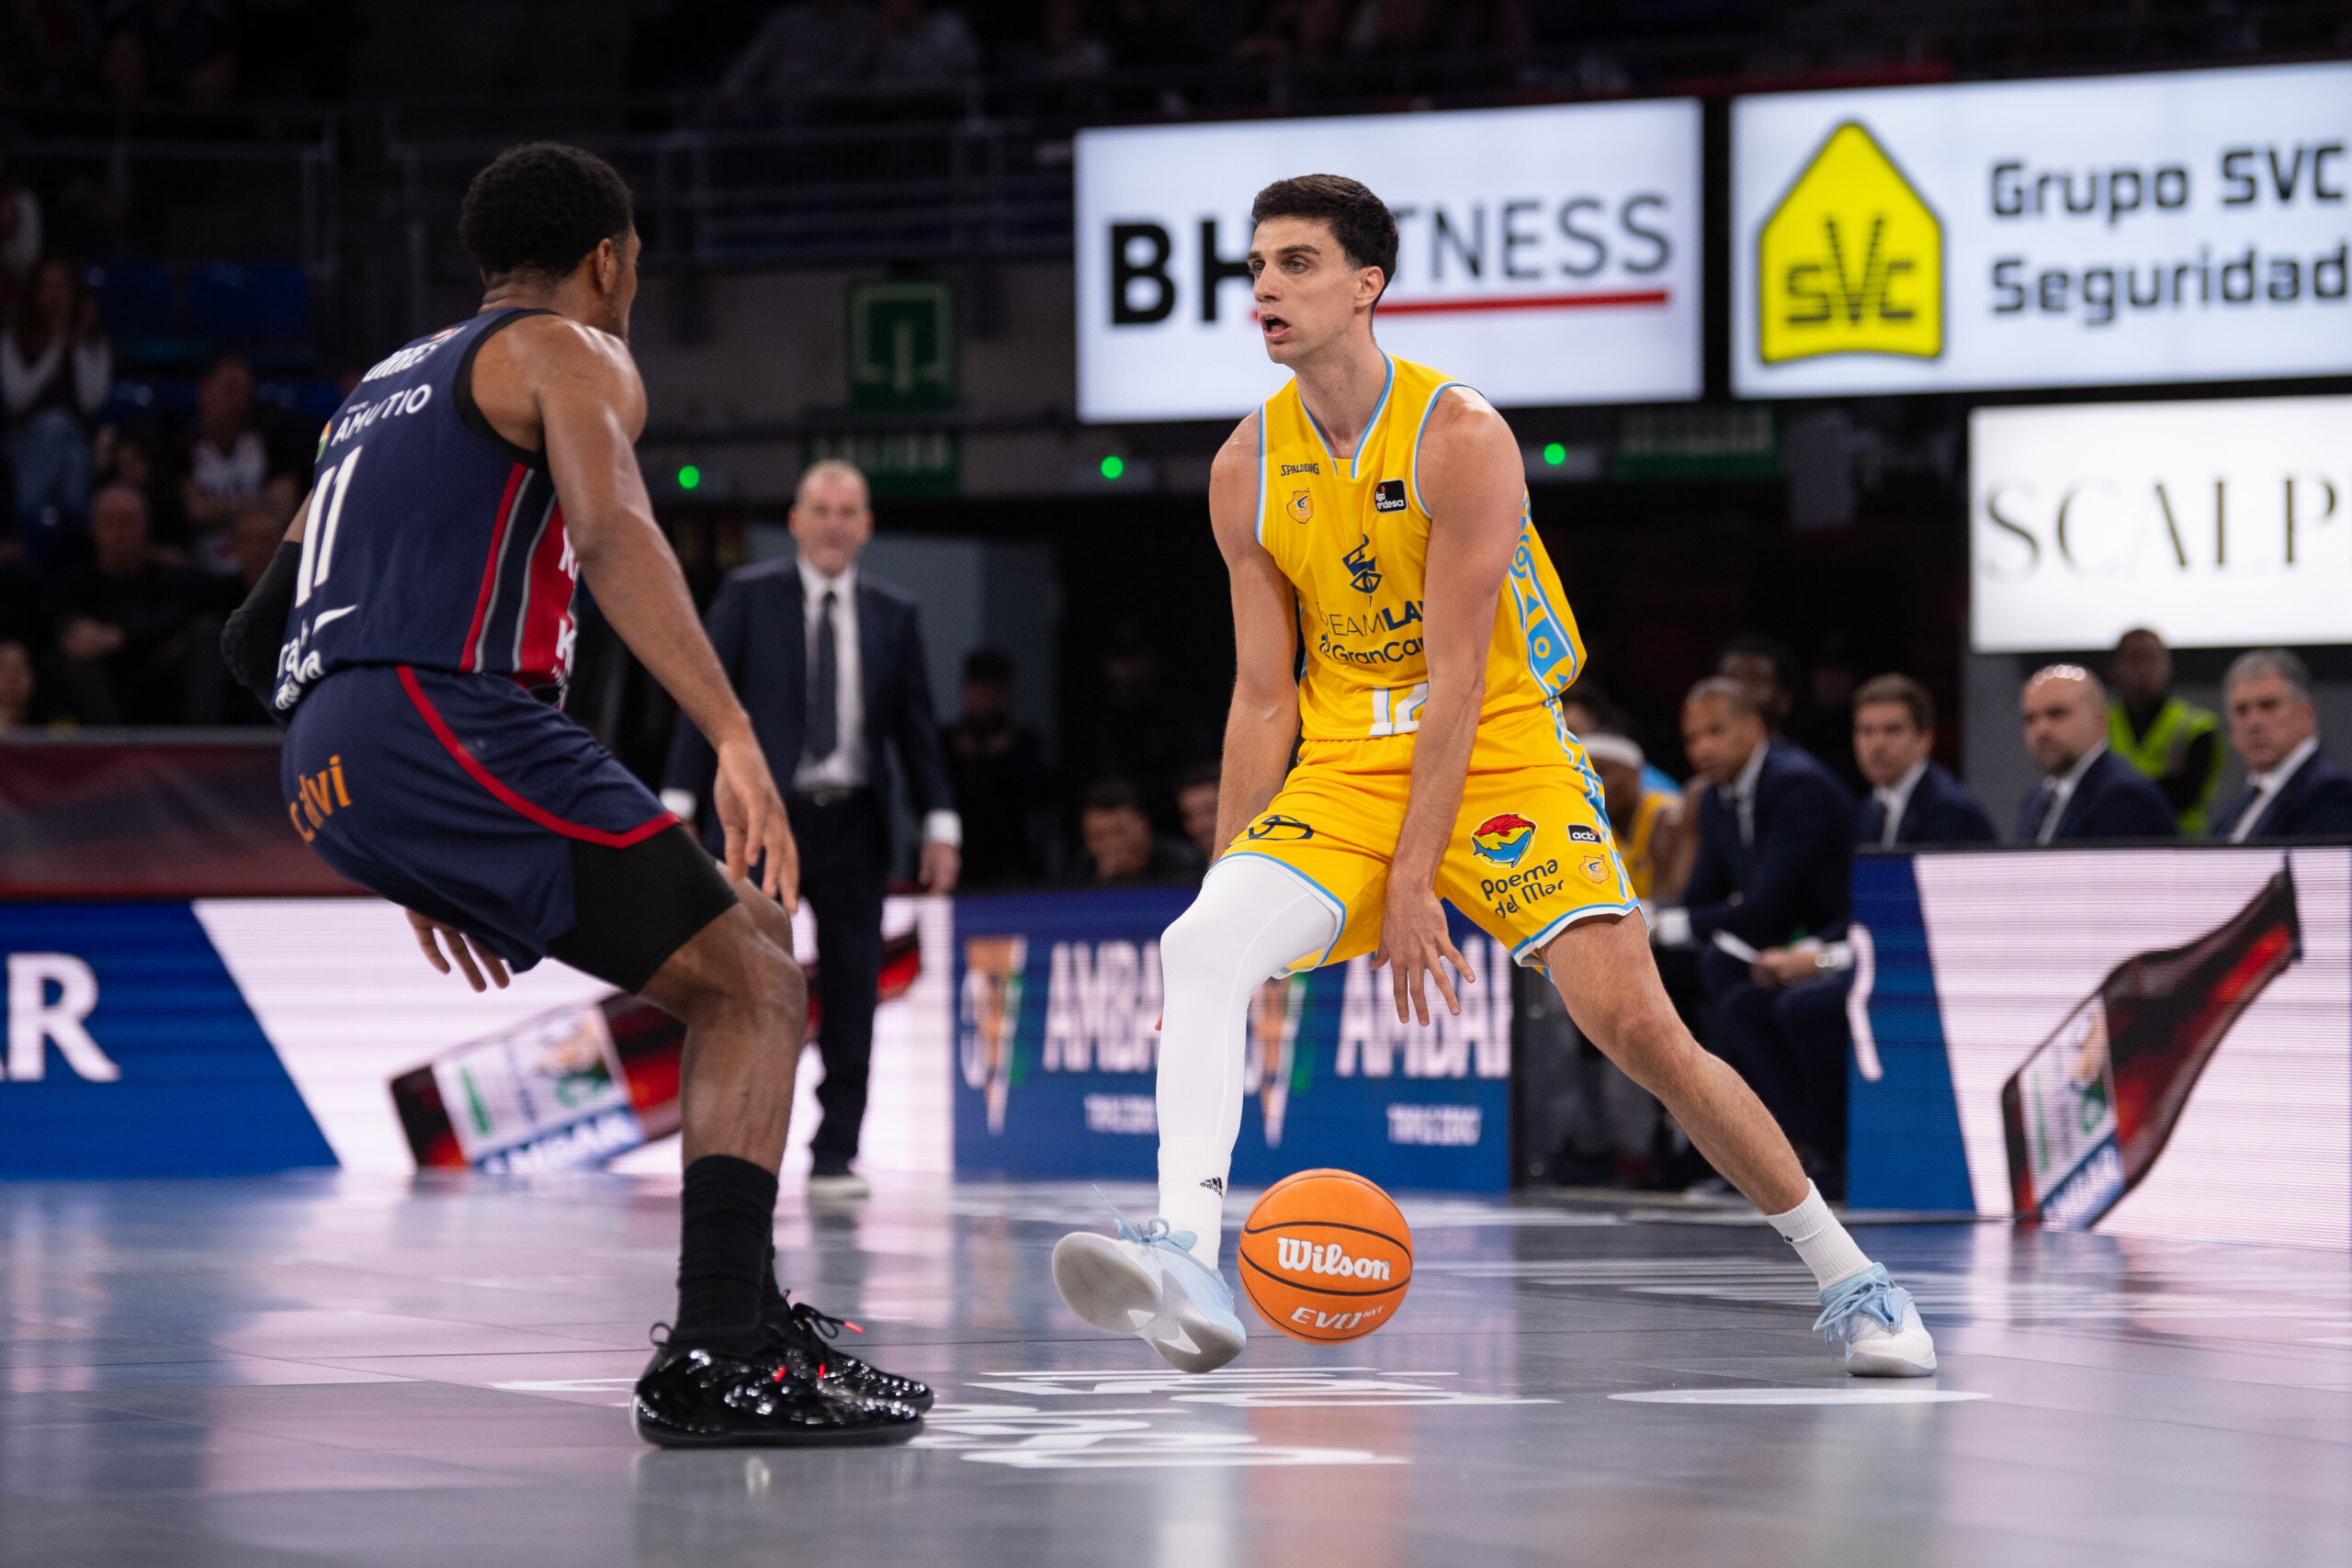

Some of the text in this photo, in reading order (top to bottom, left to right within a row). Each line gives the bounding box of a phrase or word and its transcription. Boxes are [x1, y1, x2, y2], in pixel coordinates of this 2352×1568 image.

[1992, 143, 2346, 227] Grupo SVC
[1992, 242, 2350, 329] Seguridad
[330, 383, 432, 447] AMUTIO
[1281, 462, 1319, 477] SPALDING
[295, 446, 364, 609] 11
[1572, 830, 1596, 841] acb
[1480, 859, 1559, 902] Poema
[1494, 879, 1564, 919] del Mar
[0, 952, 122, 1082] R
[1277, 1236, 1390, 1281] Wilson
